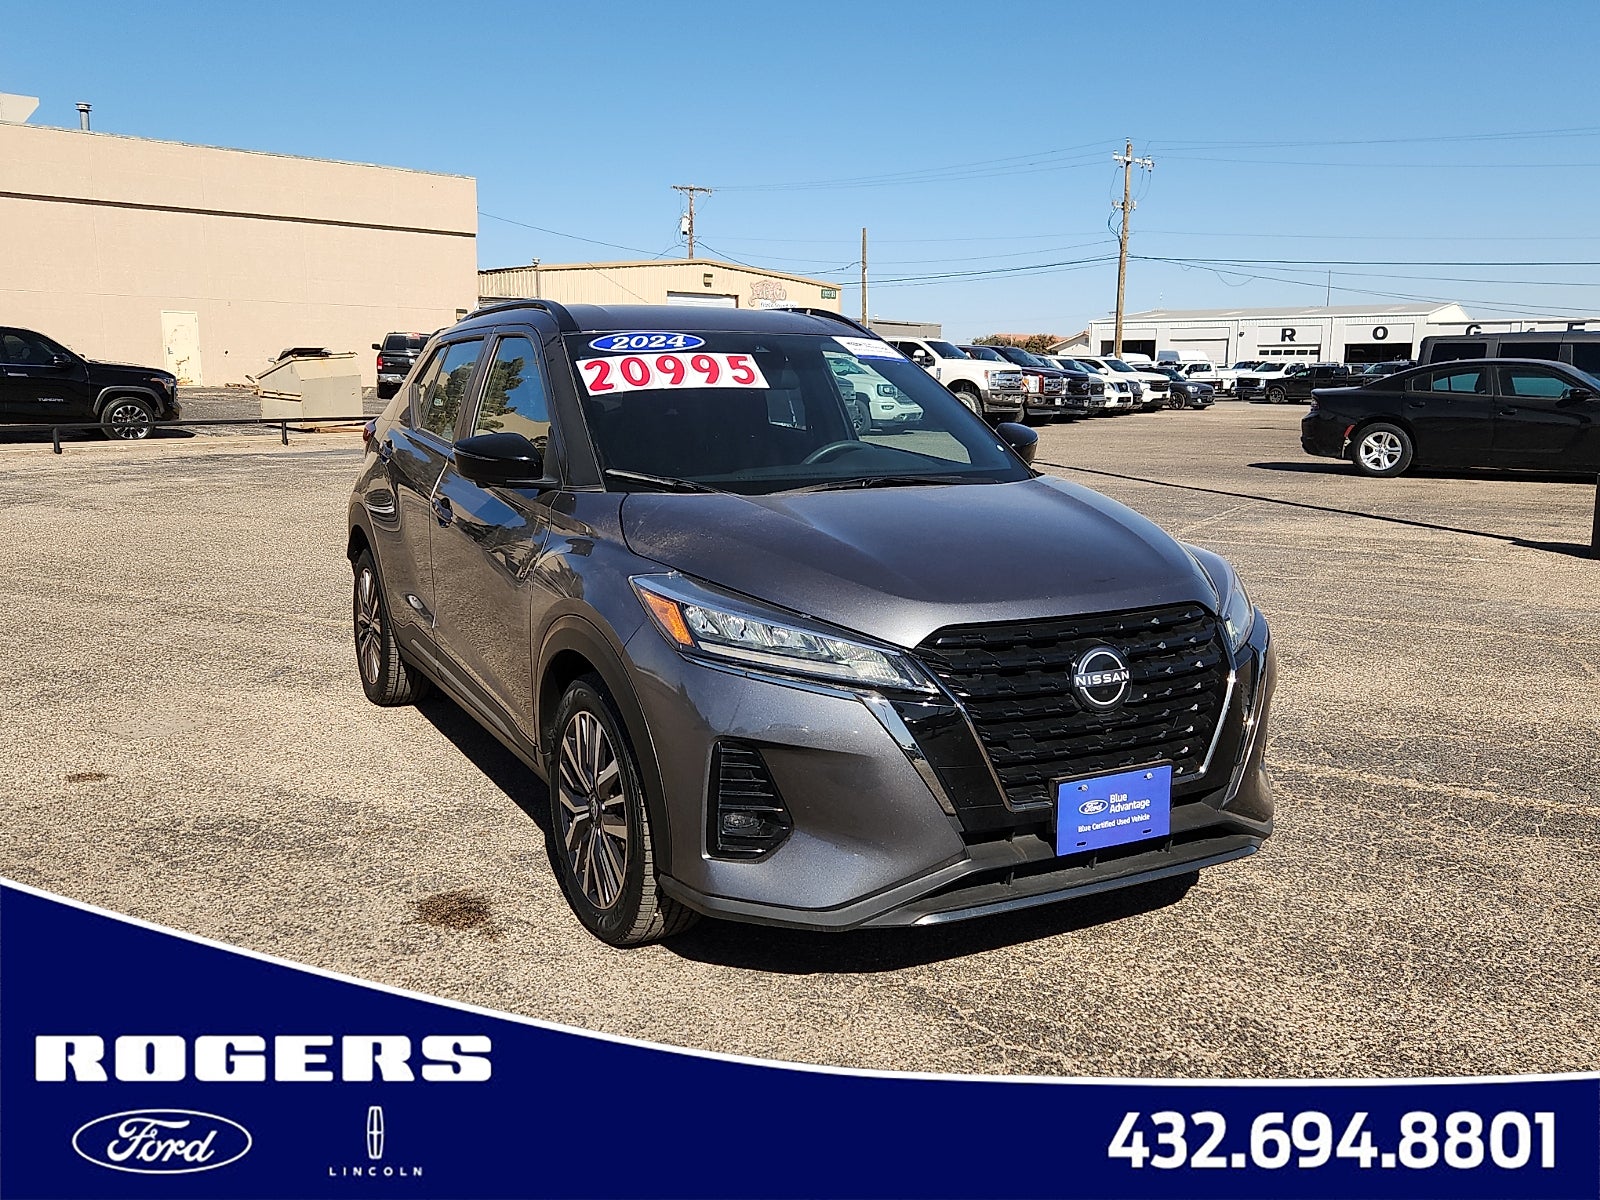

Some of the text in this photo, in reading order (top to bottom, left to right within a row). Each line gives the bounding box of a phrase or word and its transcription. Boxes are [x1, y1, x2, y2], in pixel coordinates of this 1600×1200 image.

[610, 334, 687, 350] 2024
[584, 354, 756, 392] 20995
[1075, 670, 1130, 686] NISSAN
[1109, 793, 1128, 803] Blue
[1109, 799, 1151, 814] Advantage
[1077, 813, 1151, 833] Blue Certified Used Vehicle
